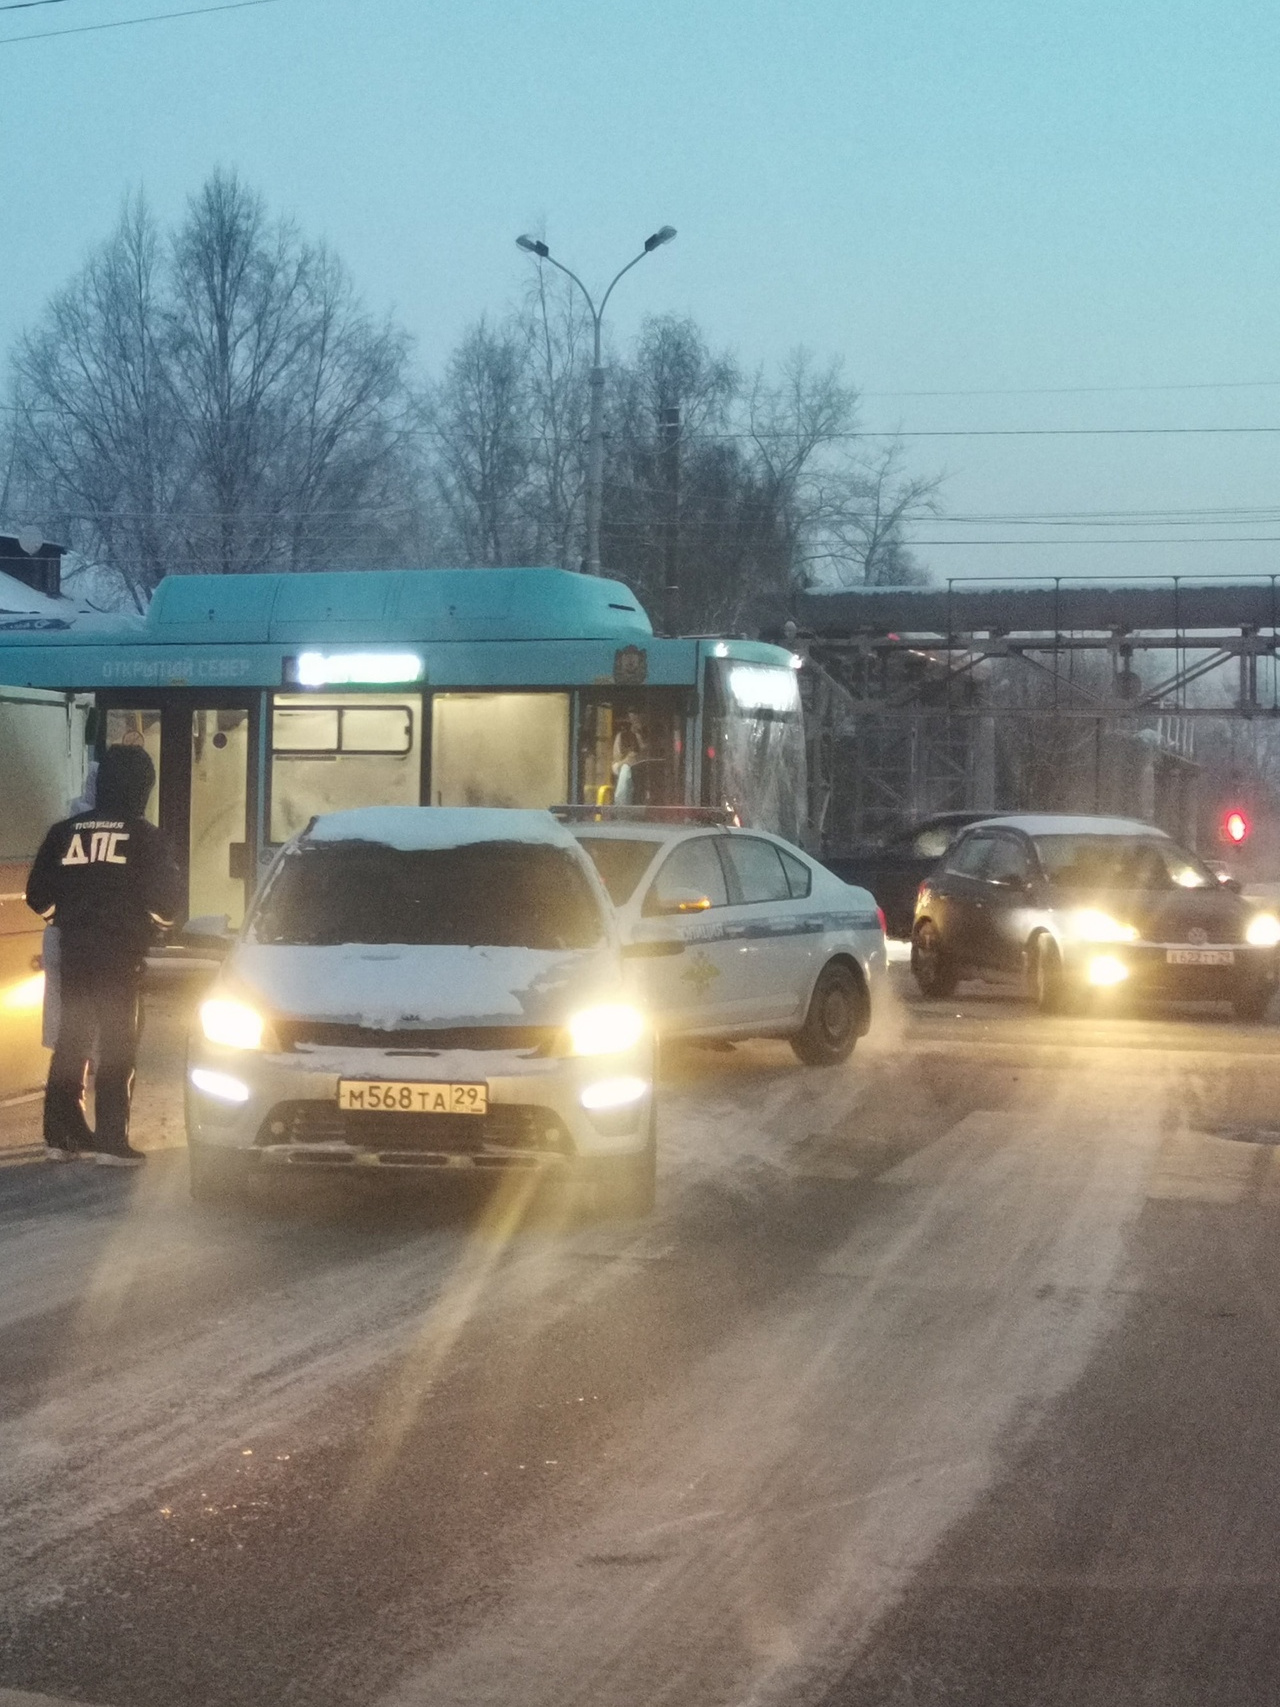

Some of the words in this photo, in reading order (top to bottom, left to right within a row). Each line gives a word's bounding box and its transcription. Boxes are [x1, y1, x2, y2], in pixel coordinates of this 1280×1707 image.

[102, 658, 193, 678] ОТКРЫТЫЙ
[199, 658, 250, 677] СЕВЕР
[75, 820, 125, 831] ПОЛИЦИЯ
[62, 832, 130, 866] ДПС
[348, 1085, 447, 1111] М568ТА
[454, 1086, 478, 1105] 29
